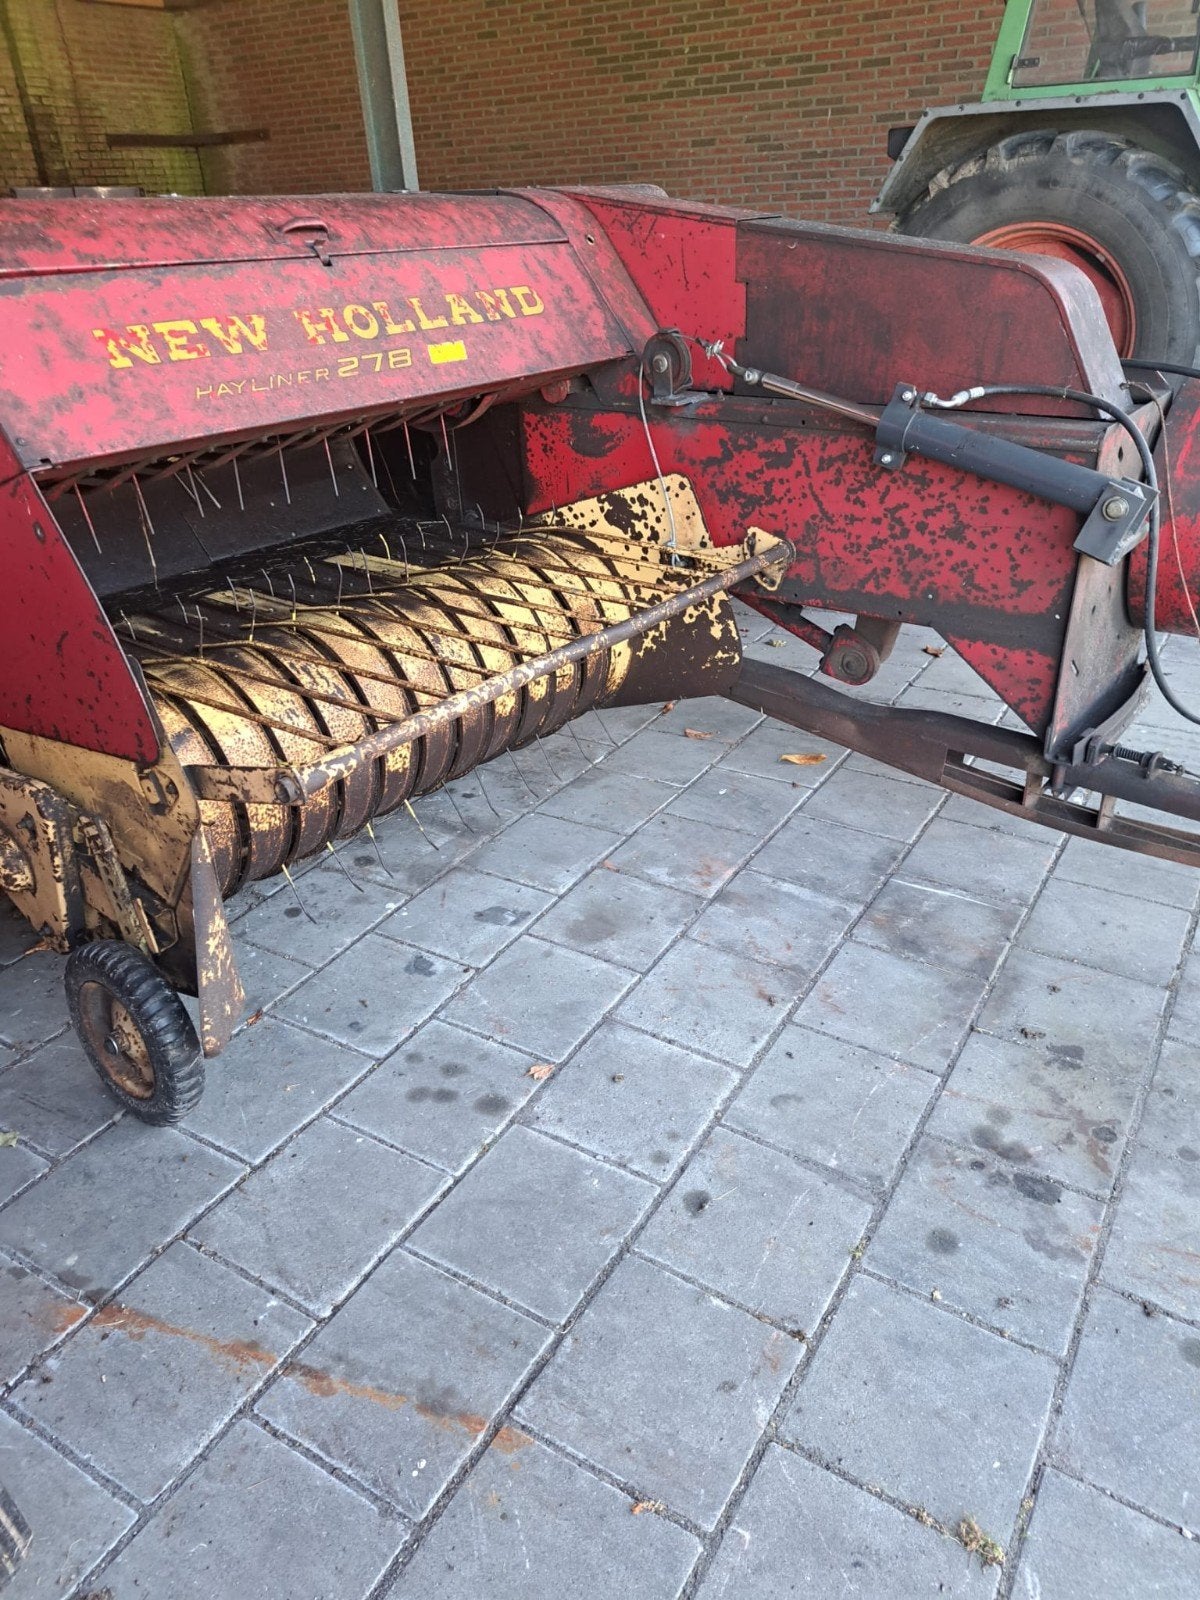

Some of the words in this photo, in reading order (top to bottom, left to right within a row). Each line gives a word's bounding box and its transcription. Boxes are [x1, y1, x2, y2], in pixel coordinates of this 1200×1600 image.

[92, 314, 268, 369] NEW
[293, 286, 545, 345] HOLLAND
[195, 368, 330, 400] HAYLINER
[337, 348, 413, 378] 278
